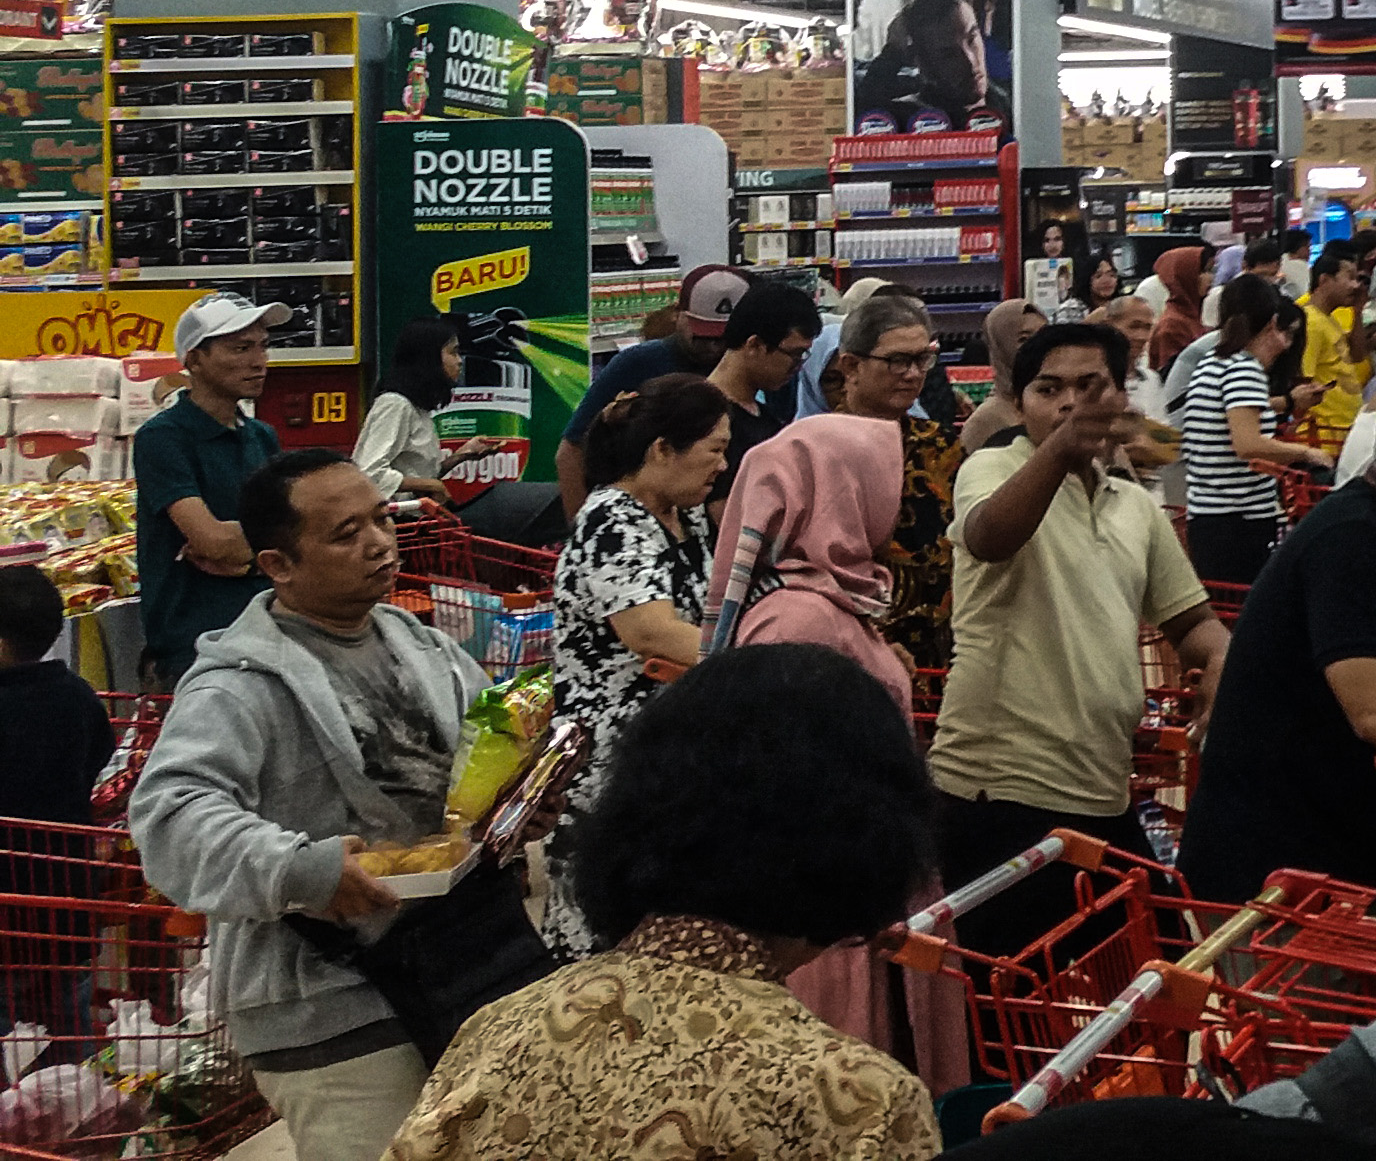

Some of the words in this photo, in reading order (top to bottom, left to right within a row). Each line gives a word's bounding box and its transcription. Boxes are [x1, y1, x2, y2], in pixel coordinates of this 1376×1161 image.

[447, 25, 514, 65] DOUBLE
[443, 57, 510, 95] NOZZLE
[413, 147, 553, 175] DOUBLE
[413, 177, 553, 204] NOZZLE
[413, 205, 469, 218] NYAMUK
[470, 204, 501, 217] MATI
[513, 204, 552, 216] DETIK
[500, 220, 553, 231] BLOSSOM
[436, 253, 527, 295] BARU!
[312, 392, 347, 423] 09
